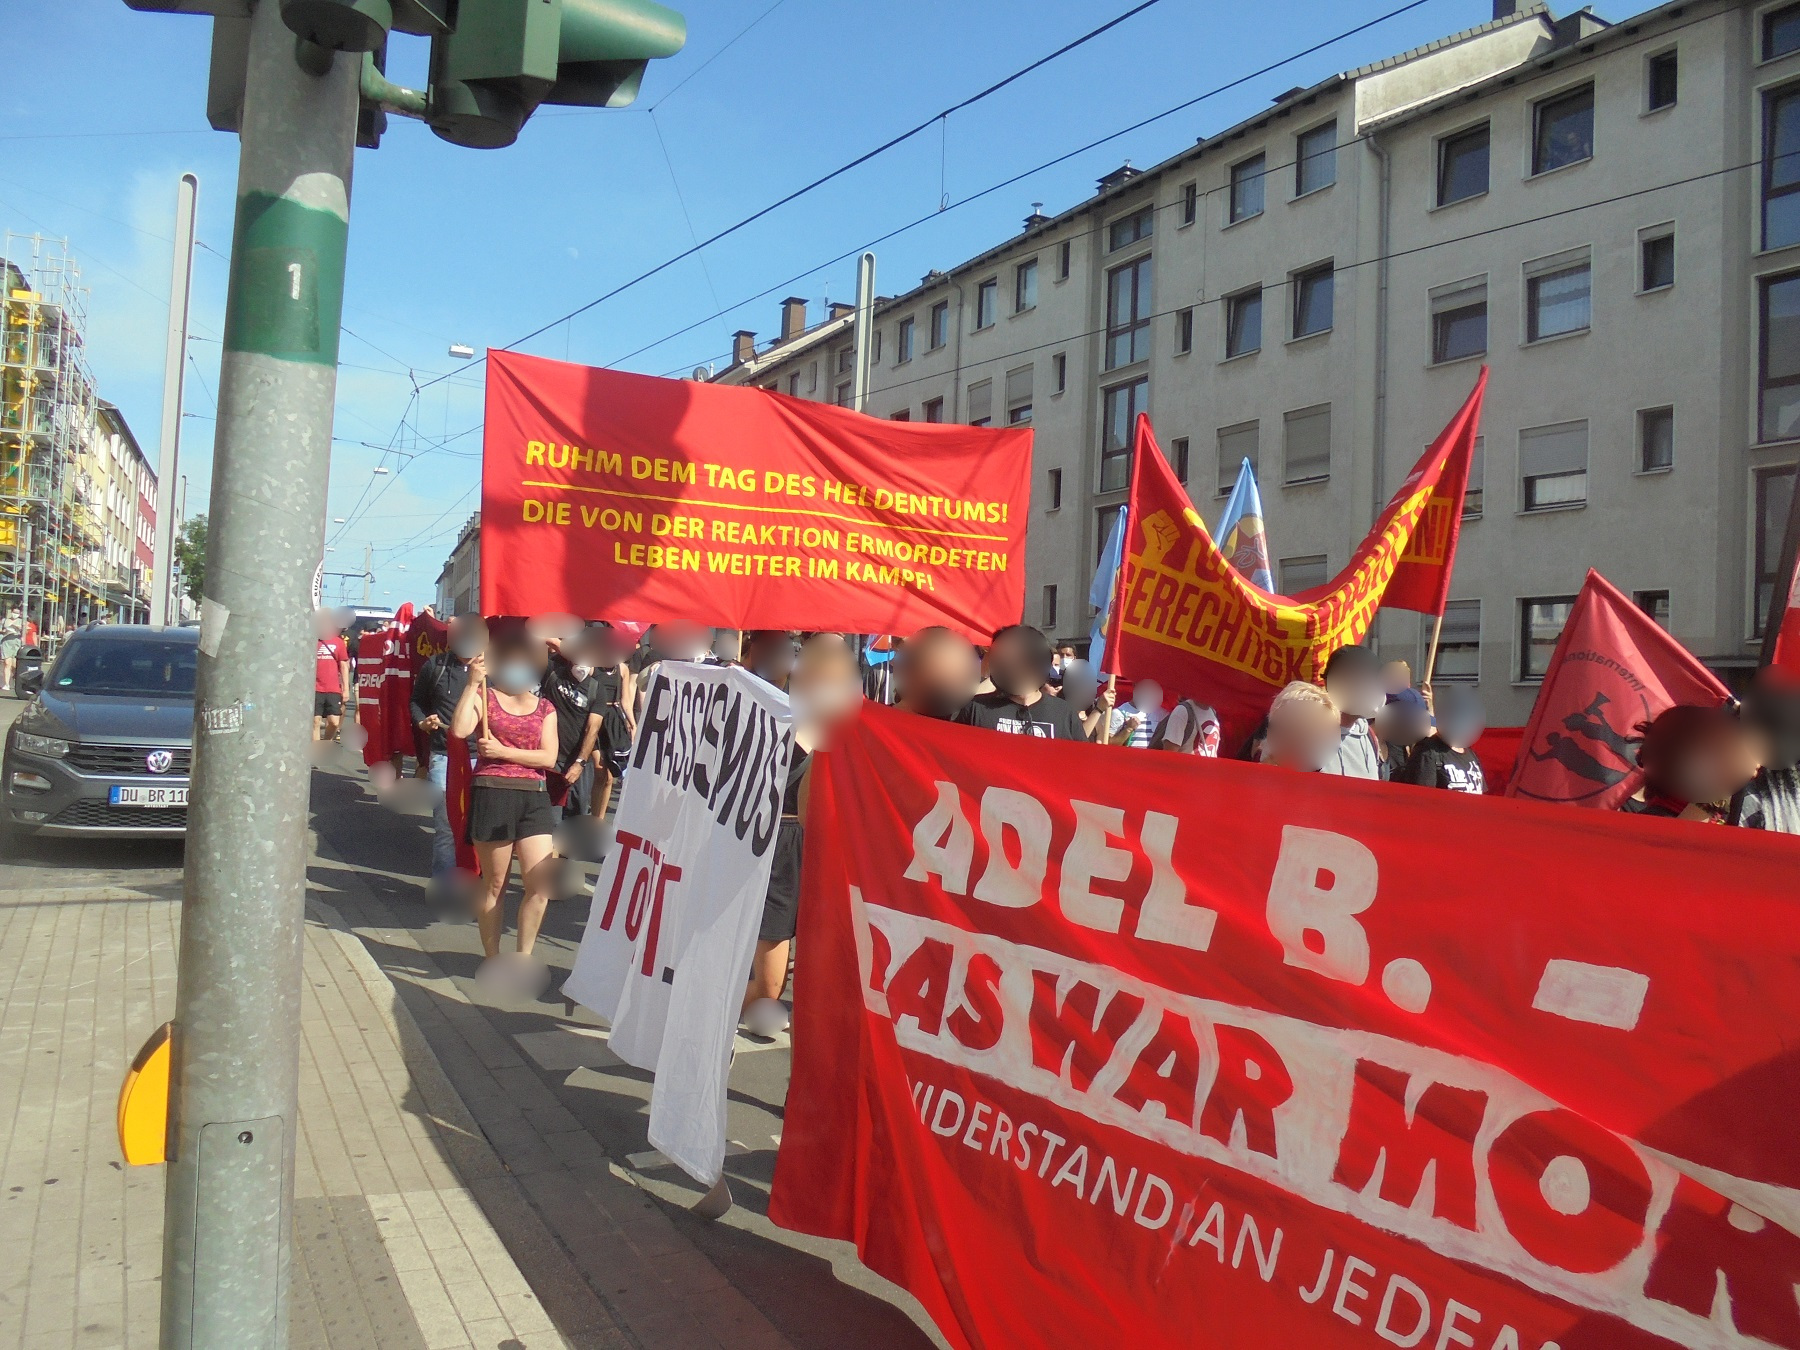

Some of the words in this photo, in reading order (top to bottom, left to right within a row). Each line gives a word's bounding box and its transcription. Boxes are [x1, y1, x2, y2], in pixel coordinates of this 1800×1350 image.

[288, 263, 302, 300] 1
[525, 440, 623, 476] RUHM
[631, 456, 696, 485] DEM
[703, 463, 756, 492] TAG
[764, 471, 816, 497] DES
[823, 479, 1008, 524] HELDENTUMS!
[522, 499, 572, 525] DIE
[580, 505, 643, 534] VON
[651, 514, 704, 539] DER
[711, 520, 839, 550] REAKTION
[846, 532, 1007, 572] ERMORDETEN
[614, 541, 700, 572] LEBEN
[707, 551, 801, 577] WEITER
[808, 557, 838, 580] IM
[845, 561, 935, 591] KAMPF!
[121, 788, 139, 802] DU
[148, 789, 165, 802] BR
[903, 780, 1218, 952] ADEL
[1266, 824, 1432, 1014] B.
[1031, 968, 1295, 1160] WAR
[1188, 1202, 1284, 1283] AN
